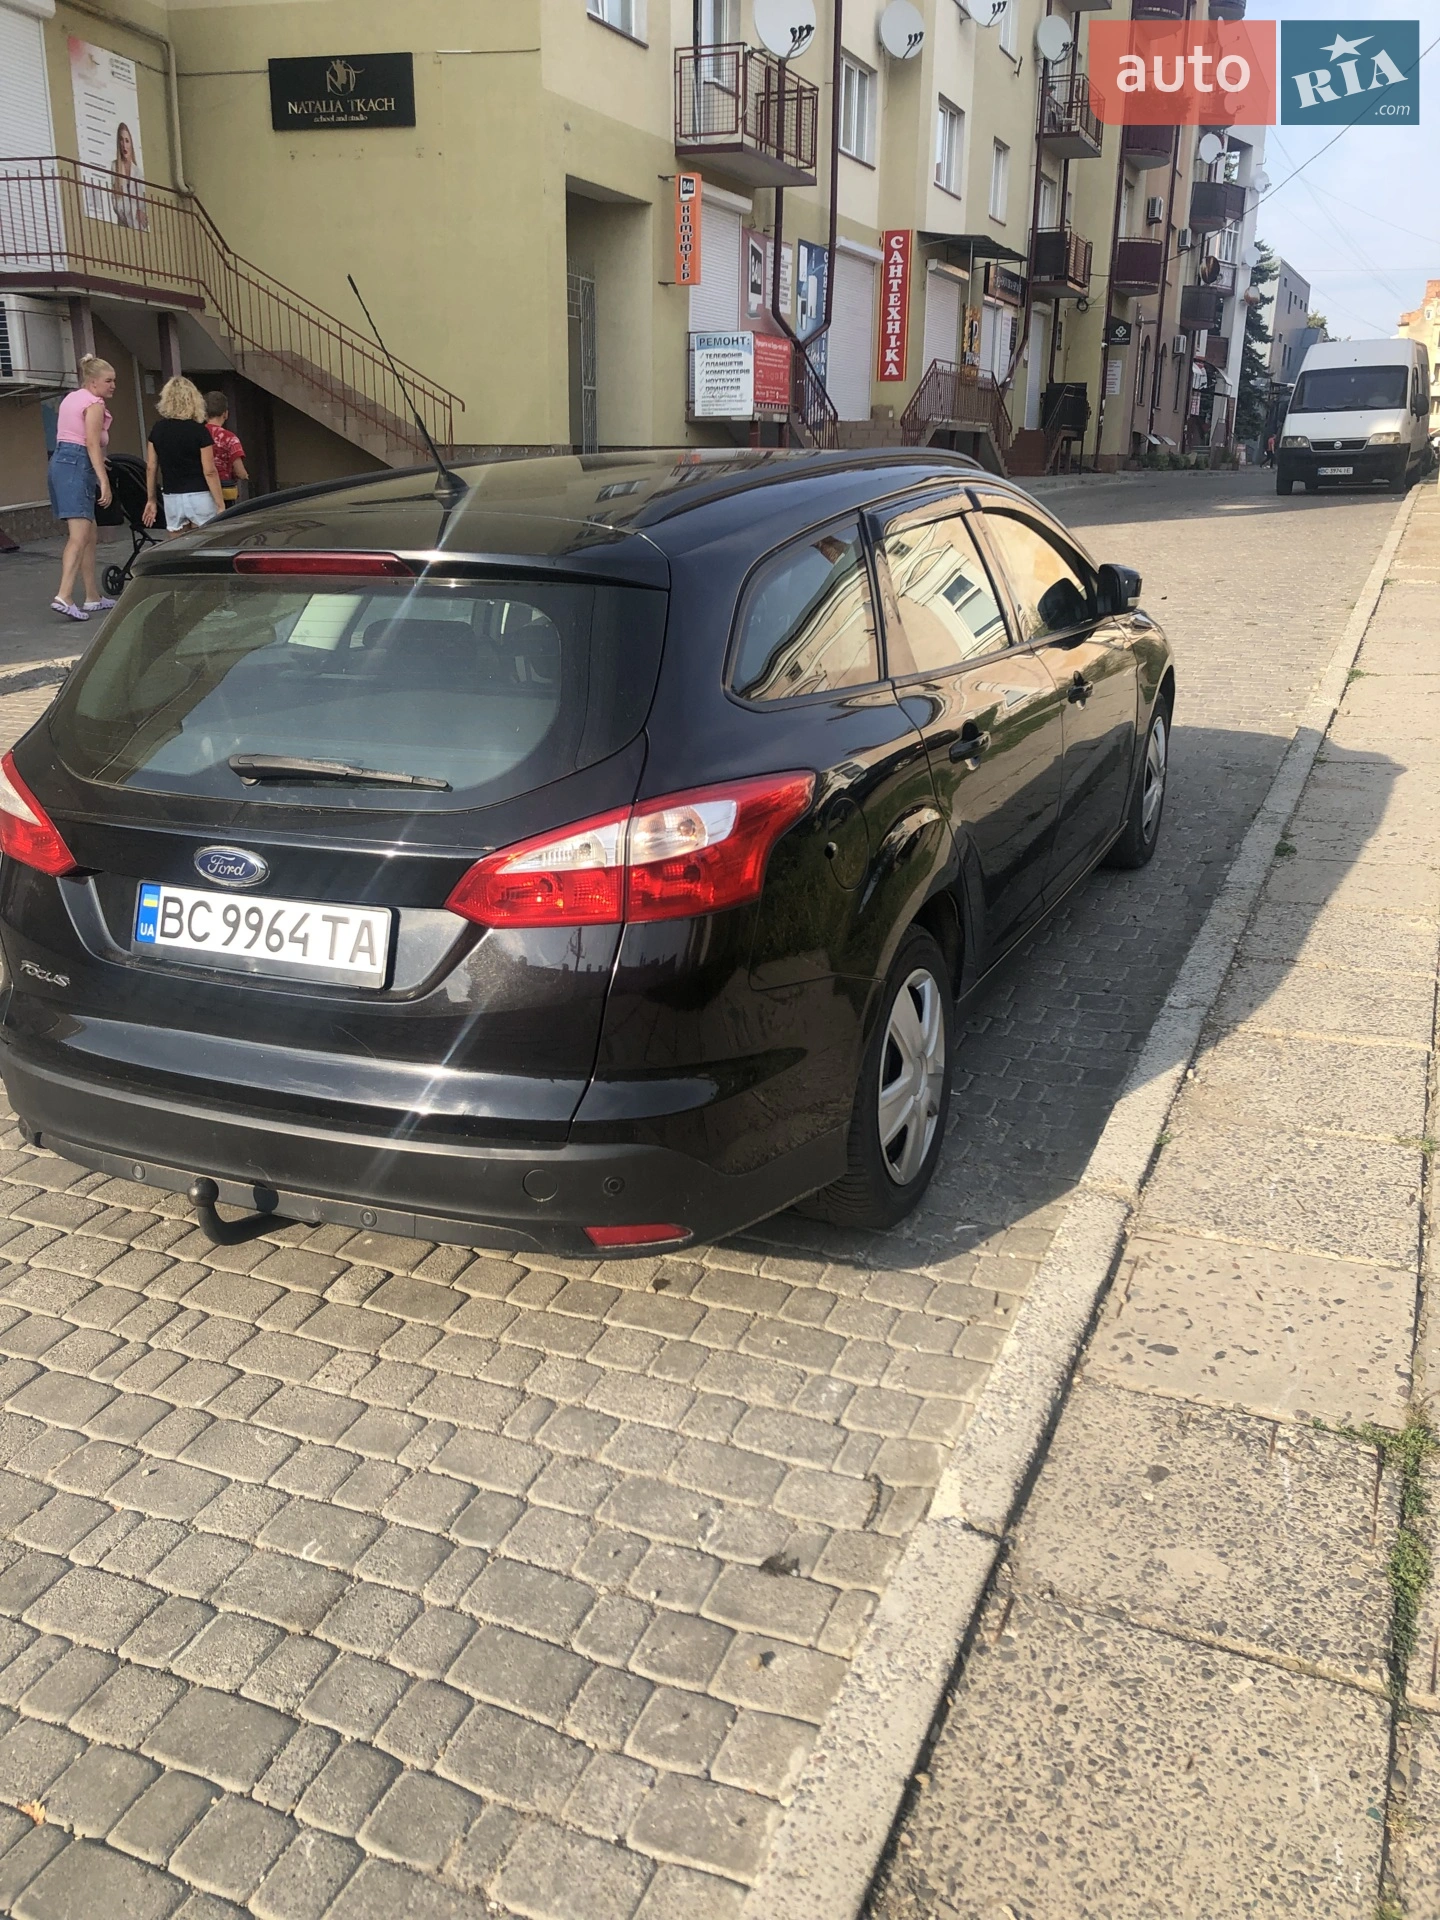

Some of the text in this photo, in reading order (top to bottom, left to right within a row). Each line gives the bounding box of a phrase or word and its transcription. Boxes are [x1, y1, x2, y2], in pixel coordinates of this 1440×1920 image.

[288, 98, 396, 115] NATALIA TKACH
[335, 114, 348, 122] and
[348, 113, 368, 122] studio
[884, 235, 904, 376] САНТЕХНІКА
[699, 336, 750, 347] РЕМОНТ:
[206, 852, 246, 877] Ford
[140, 922, 155, 938] UA
[159, 895, 377, 966] BC 9964 TA
